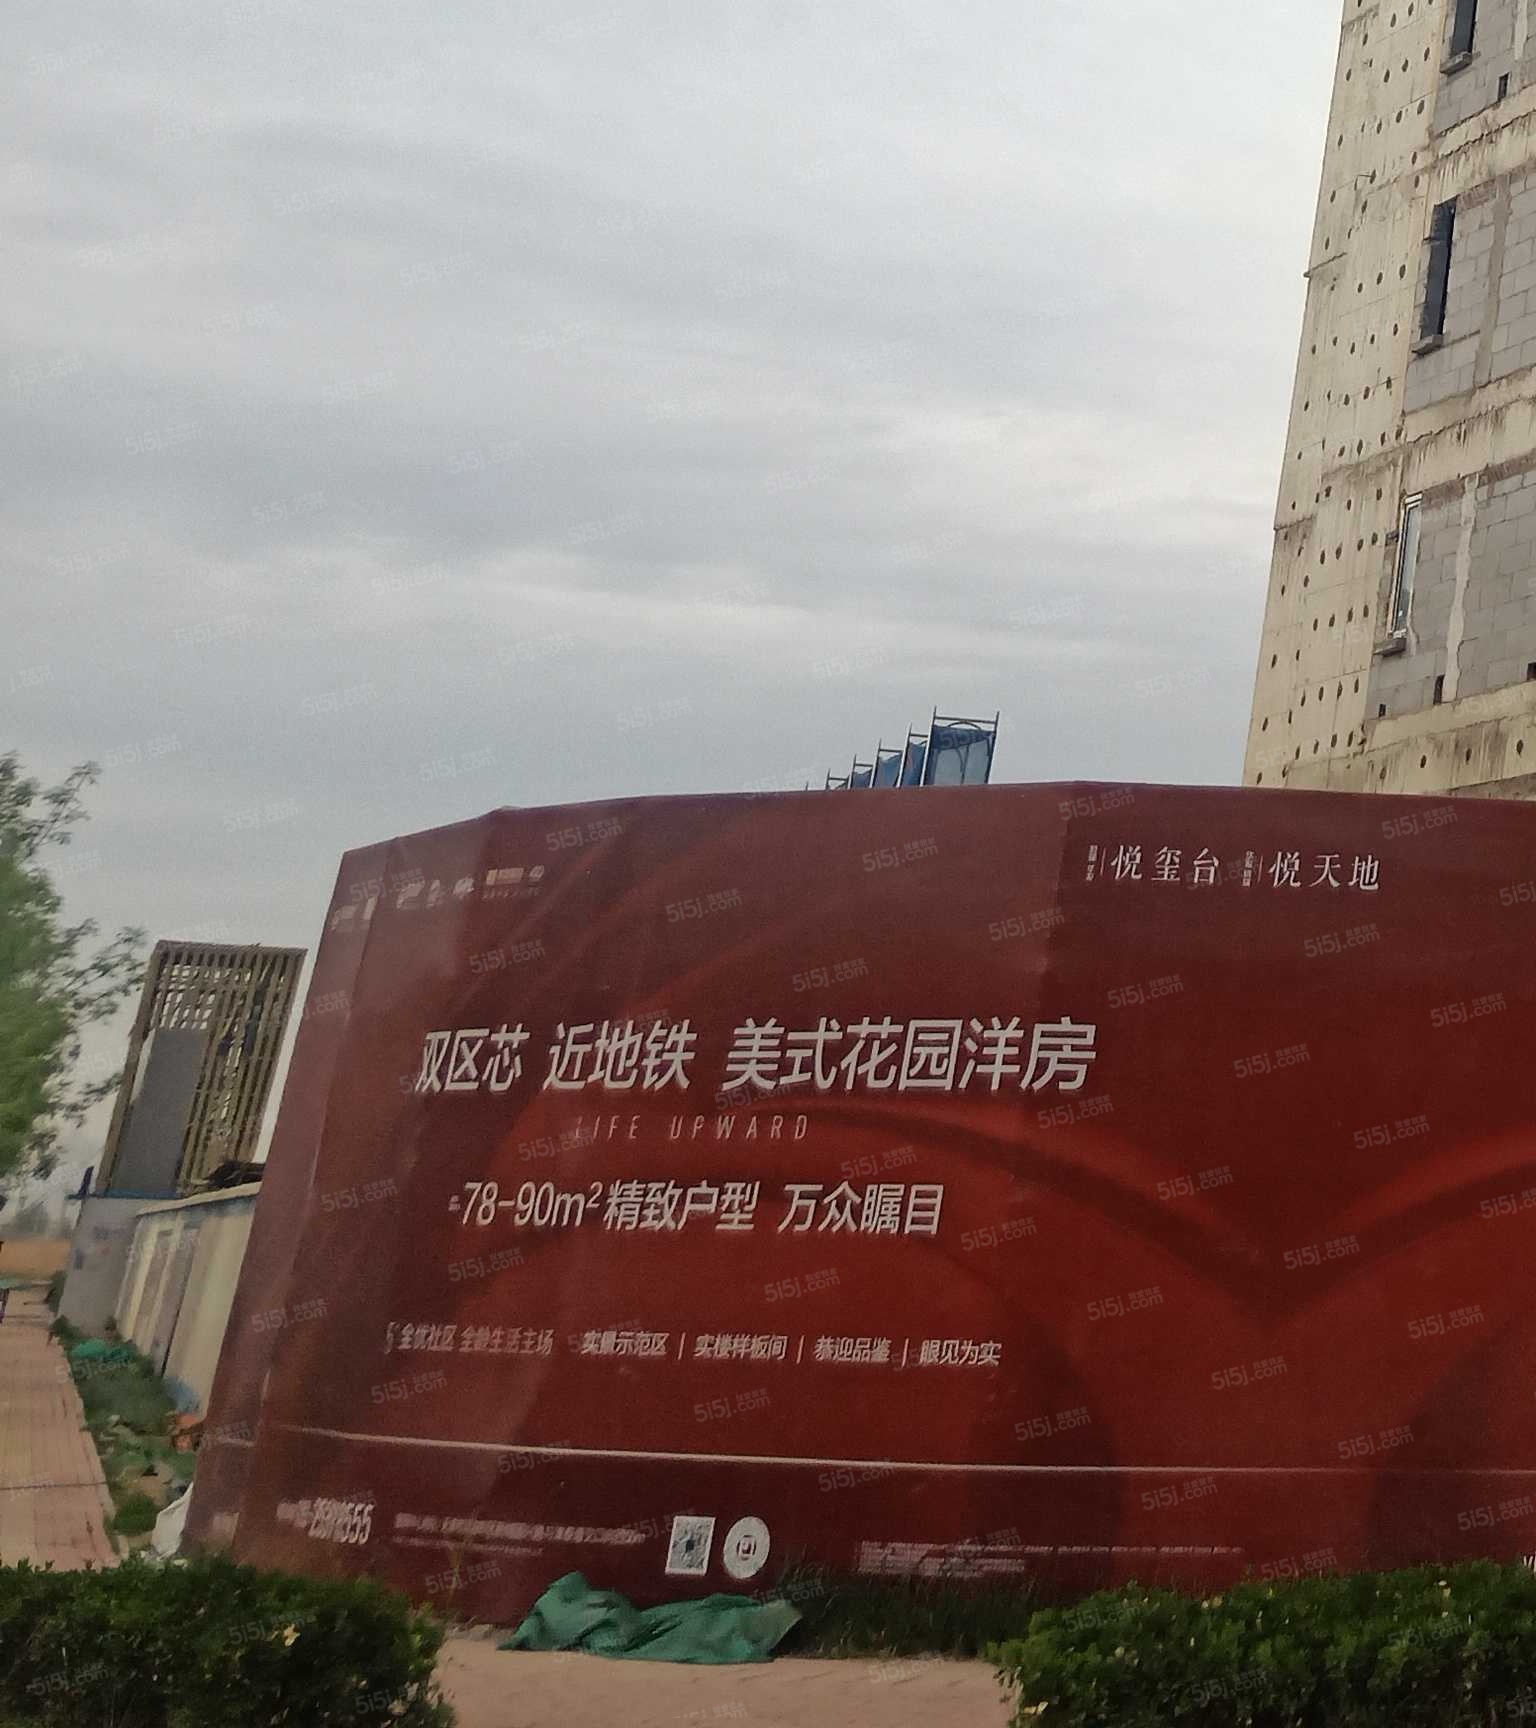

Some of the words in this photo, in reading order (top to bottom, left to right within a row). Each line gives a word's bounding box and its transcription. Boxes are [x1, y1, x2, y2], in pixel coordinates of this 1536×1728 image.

[1109, 843, 1221, 886] 悦玺台
[1267, 850, 1380, 891] 悦天地
[418, 1022, 530, 1095] 双区芯
[543, 1017, 698, 1093] 近地铁
[725, 1014, 1100, 1093] 美式花园洋房
[573, 1114, 642, 1141] LIFE
[668, 1112, 810, 1142] UPWARD
[777, 1183, 944, 1237] 万众瞩目
[812, 1334, 893, 1364] 恭迎品鉴
[917, 1338, 1003, 1368] 眼见为实
